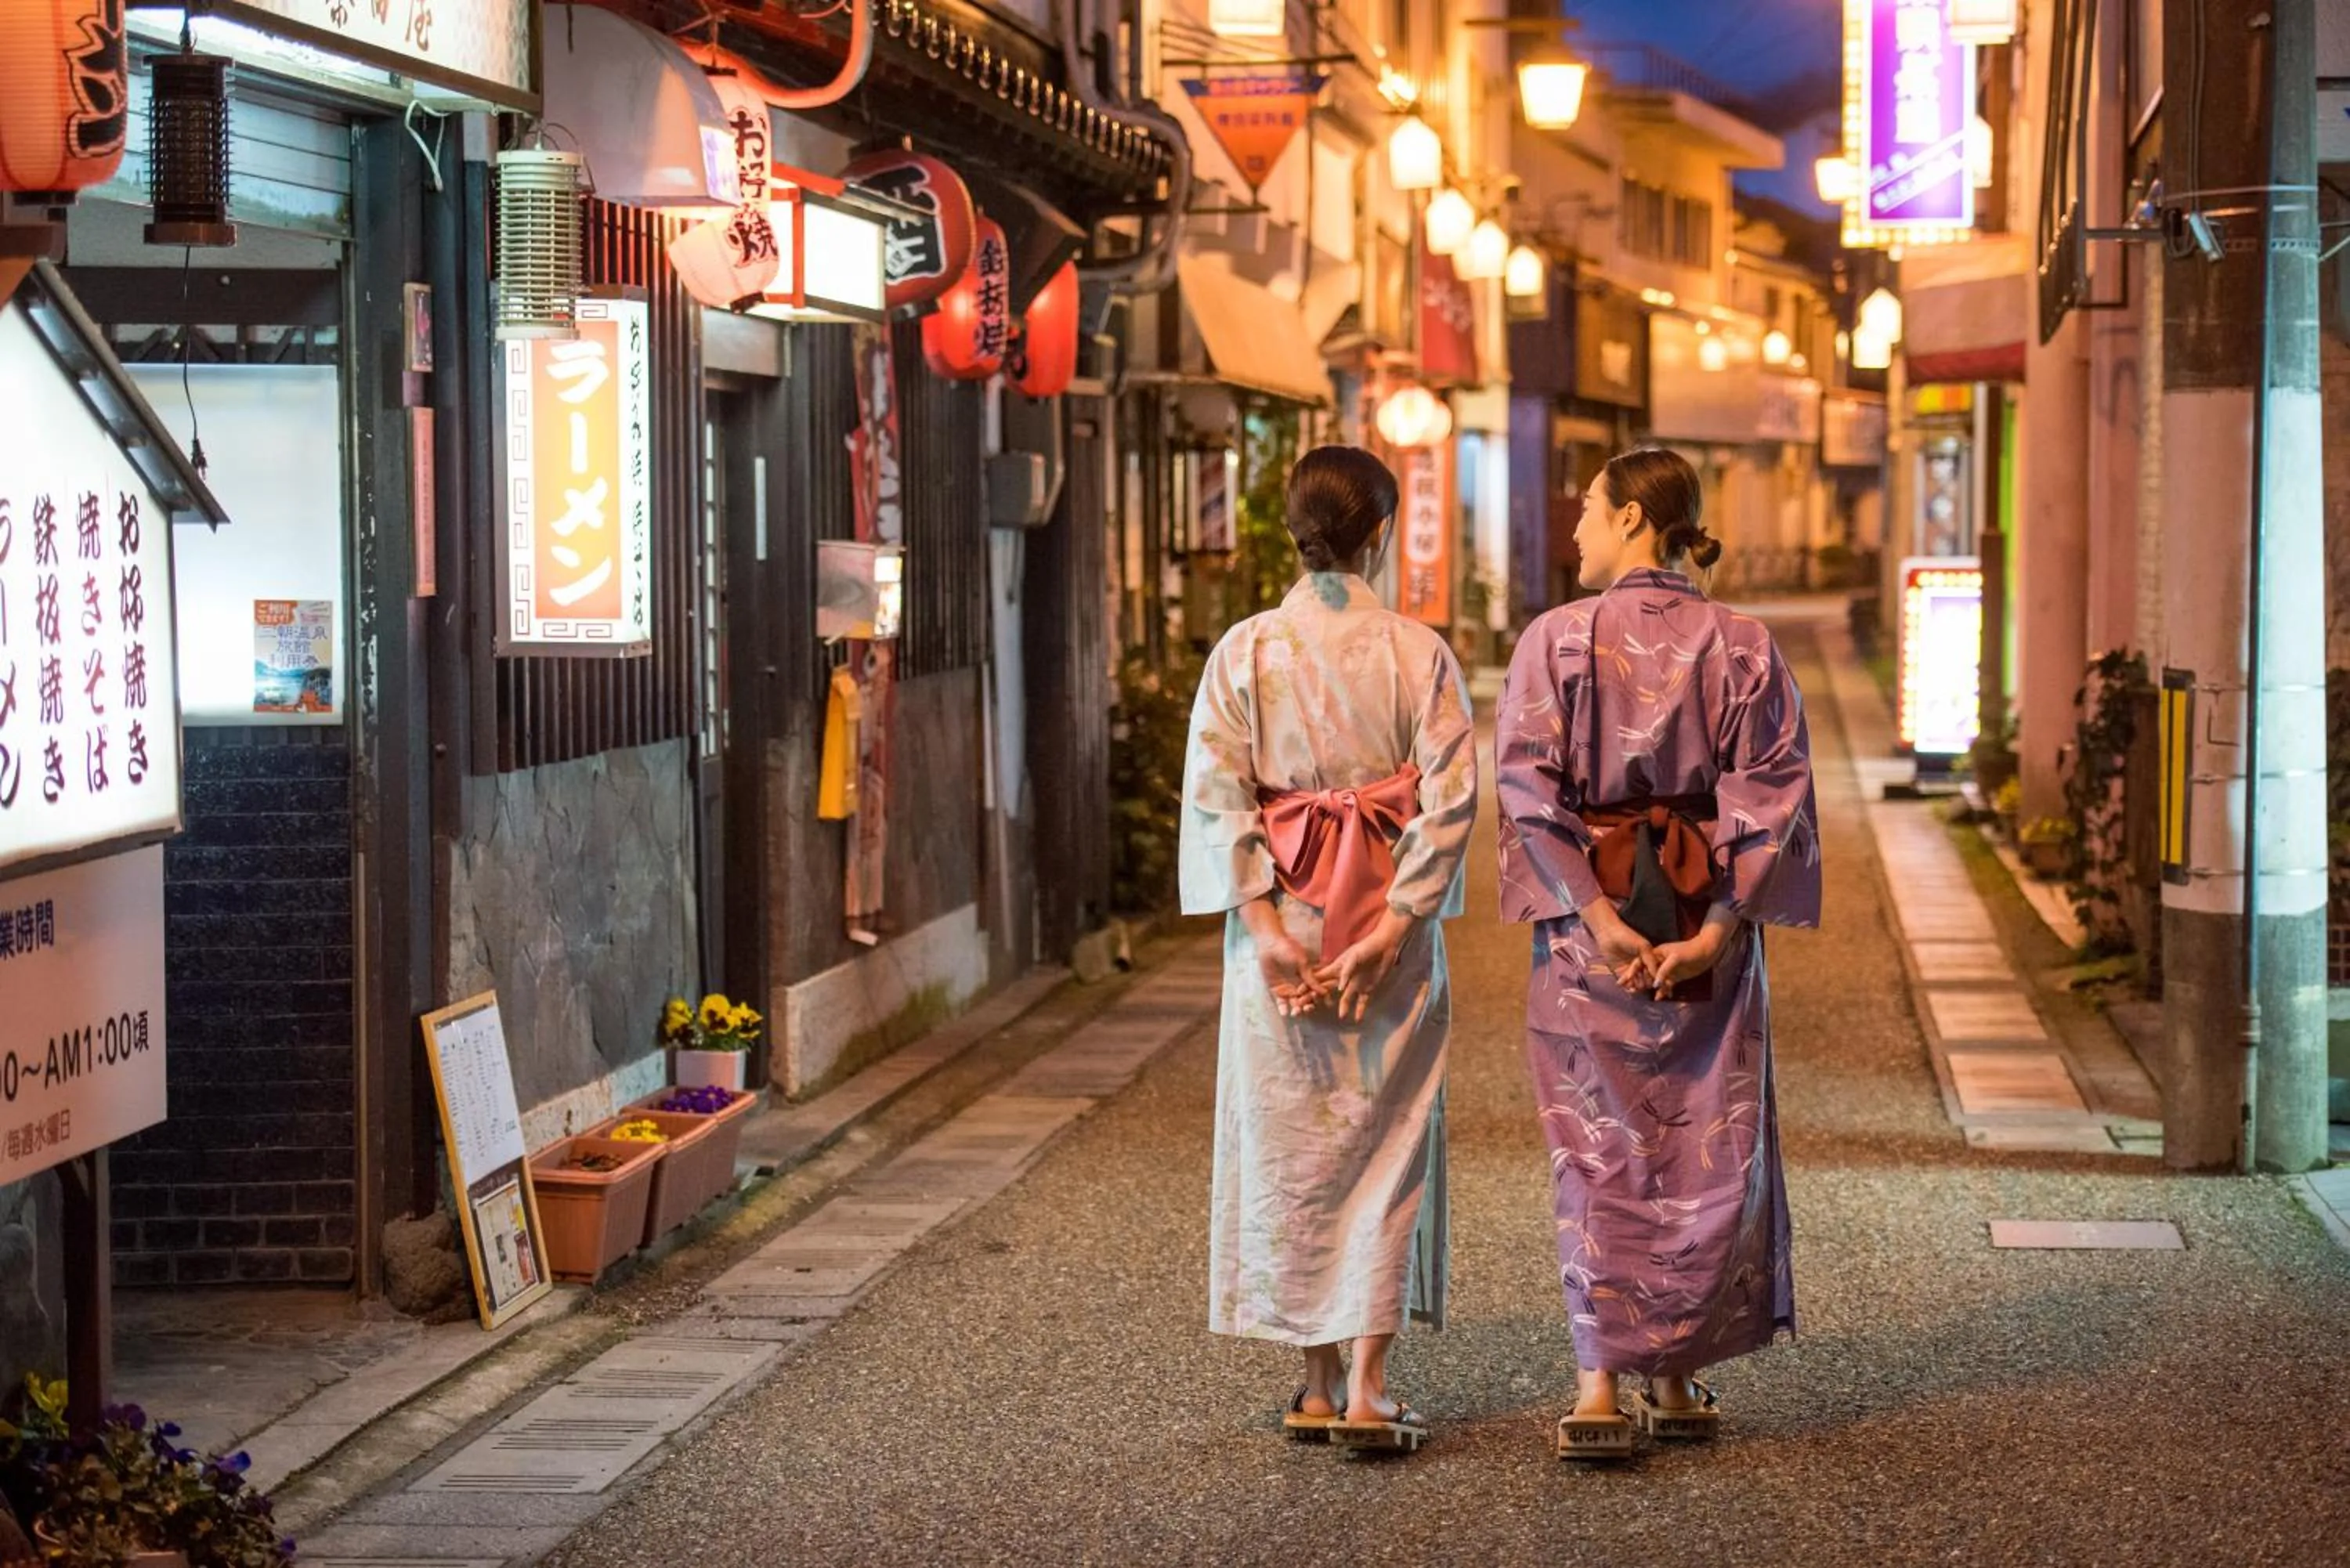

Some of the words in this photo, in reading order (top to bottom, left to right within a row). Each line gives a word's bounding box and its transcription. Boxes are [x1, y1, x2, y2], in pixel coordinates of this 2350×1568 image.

[546, 339, 613, 608] ラーメン
[33, 493, 65, 804] 鉄板焼き
[77, 490, 108, 794] 焼きそば
[118, 490, 148, 785] お好焼き
[0, 899, 55, 960] 業時間
[0, 1010, 150, 1102] 0～AM1:00頃
